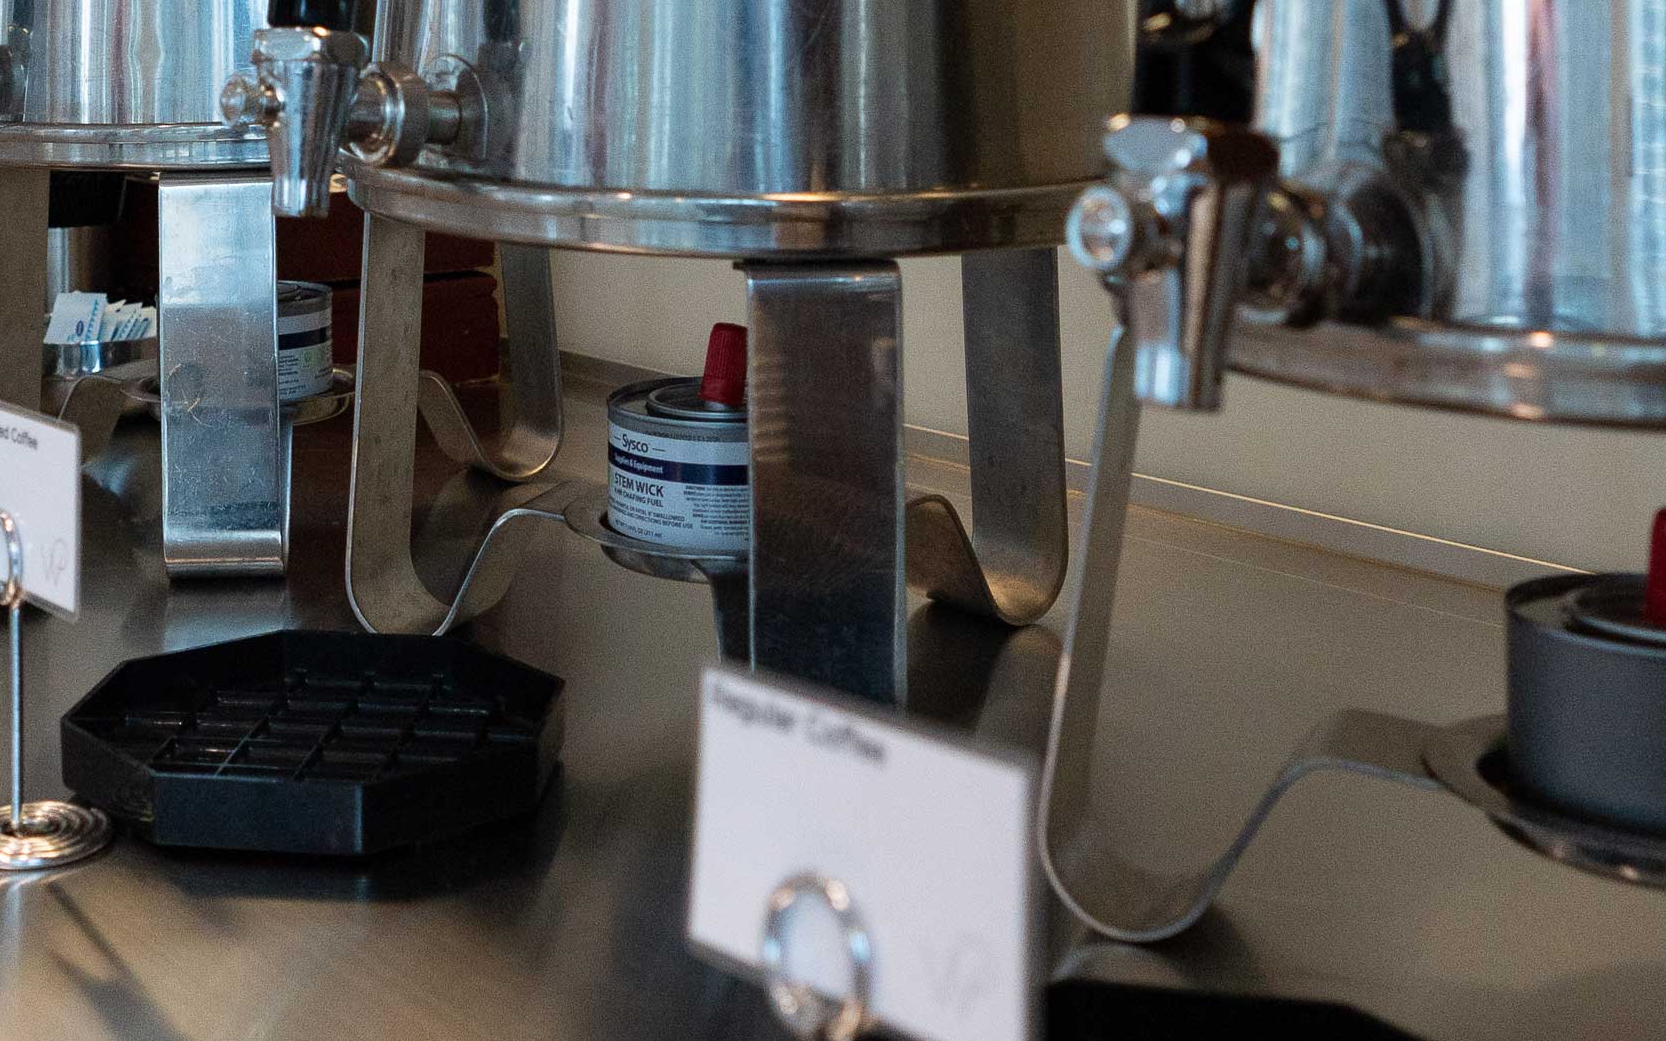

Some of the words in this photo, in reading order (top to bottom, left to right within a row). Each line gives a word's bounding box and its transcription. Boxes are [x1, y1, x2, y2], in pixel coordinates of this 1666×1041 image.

[11, 427, 38, 450] Coffee
[622, 434, 649, 453] Sysco
[614, 472, 634, 490] STEM
[635, 480, 664, 497] WICK
[647, 499, 664, 508] FUEL
